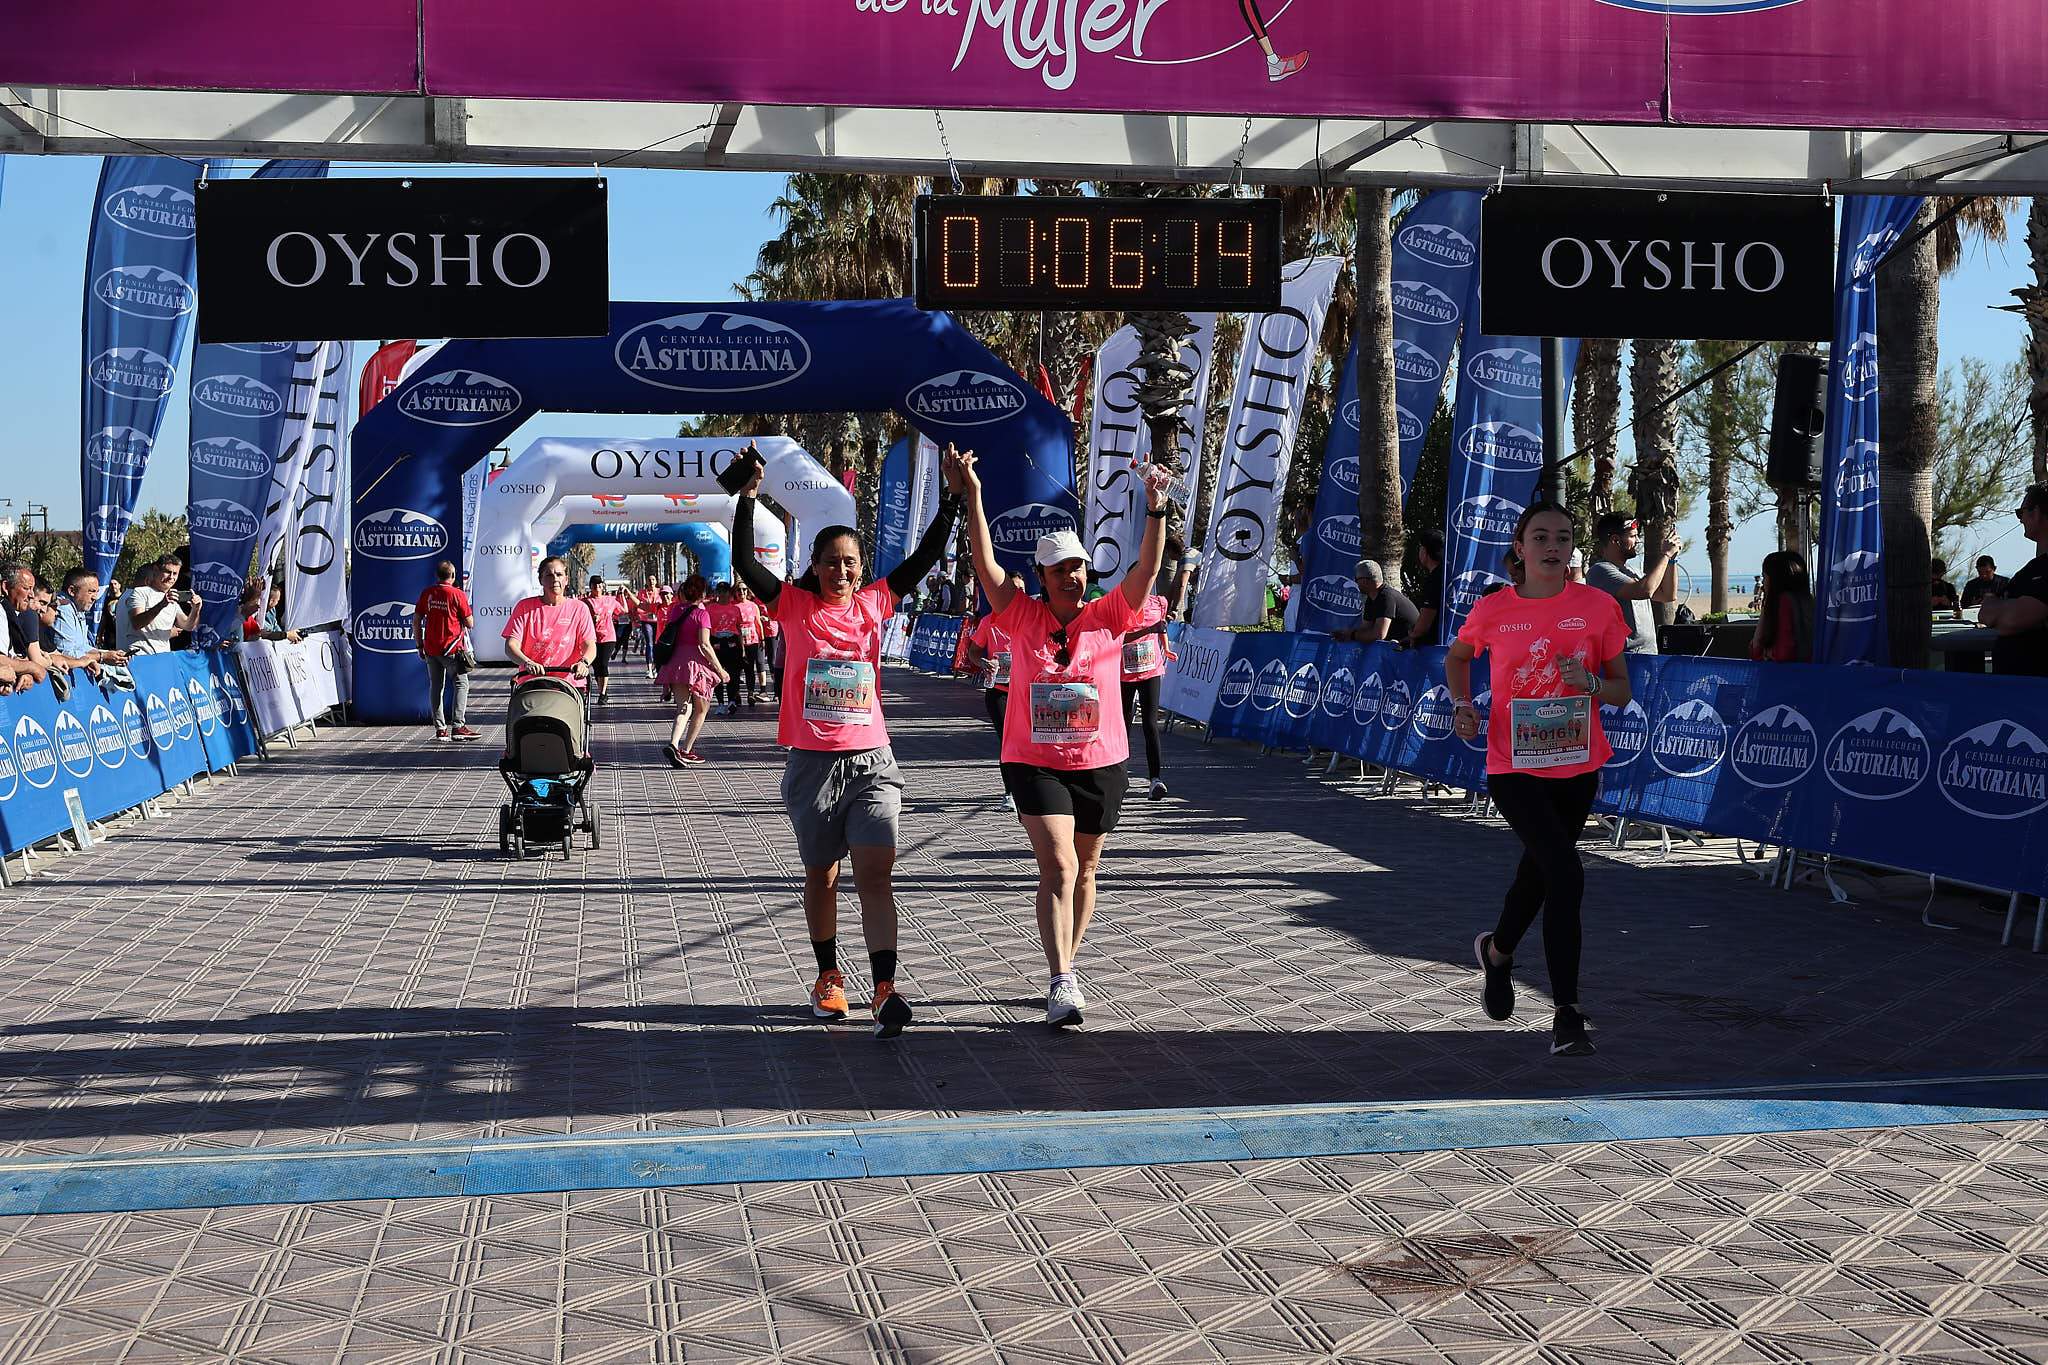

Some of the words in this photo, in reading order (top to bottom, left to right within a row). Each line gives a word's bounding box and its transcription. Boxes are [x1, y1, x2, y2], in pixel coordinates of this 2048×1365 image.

[951, 0, 1168, 91] Mujer
[112, 197, 196, 229] ASTURIAN
[266, 231, 551, 288] OYSHO
[943, 216, 1253, 289] 01:06:14
[1403, 230, 1470, 263] ASTURIANA
[1541, 237, 1785, 292] OYSHO
[1393, 294, 1451, 321] STURIANA
[660, 335, 722, 344] CENTRAL
[728, 335, 791, 344] LECHERA
[630, 336, 797, 372] ASTURIANA
[1473, 359, 1542, 389] ASTURIA
[200, 384, 275, 412] ASTURIANA
[405, 390, 513, 412] ASTURIANA
[916, 393, 1020, 413] ASTURIANA
[1215, 306, 1310, 561] OYSHO
[191, 446, 265, 473] ASTURIANA
[1464, 435, 1543, 465] ASTURIANA
[500, 484, 546, 494] OYSHO
[784, 481, 829, 491] OYSHO
[884, 480, 910, 547] Marlene
[1455, 515, 1520, 535] ASTURIAN
[358, 527, 442, 548] ASTURIANA
[480, 545, 523, 556] OYSHO
[1308, 583, 1362, 611] ASTURIAN
[480, 607, 513, 617] OYSH
[1499, 623, 1532, 633] OYSHO
[1177, 641, 1220, 684] OYSHO
[93, 728, 125, 755] ASTURIANA
[1539, 727, 1566, 741] 016
[1655, 723, 1720, 760] ASTURIANA
[1850, 737, 1884, 748] CENTRAL
[1885, 740, 1921, 752] LECHERA
[18, 744, 56, 773] ASTURIANA
[59, 735, 92, 763] ASTURIANA
[1735, 732, 1809, 769] ASTURIANA
[1829, 738, 1919, 781] ASTURIANA
[1965, 751, 2003, 764] CENTRAL
[2006, 755, 2048, 769] LECHERA
[1944, 750, 2047, 800] ASTURIANA
